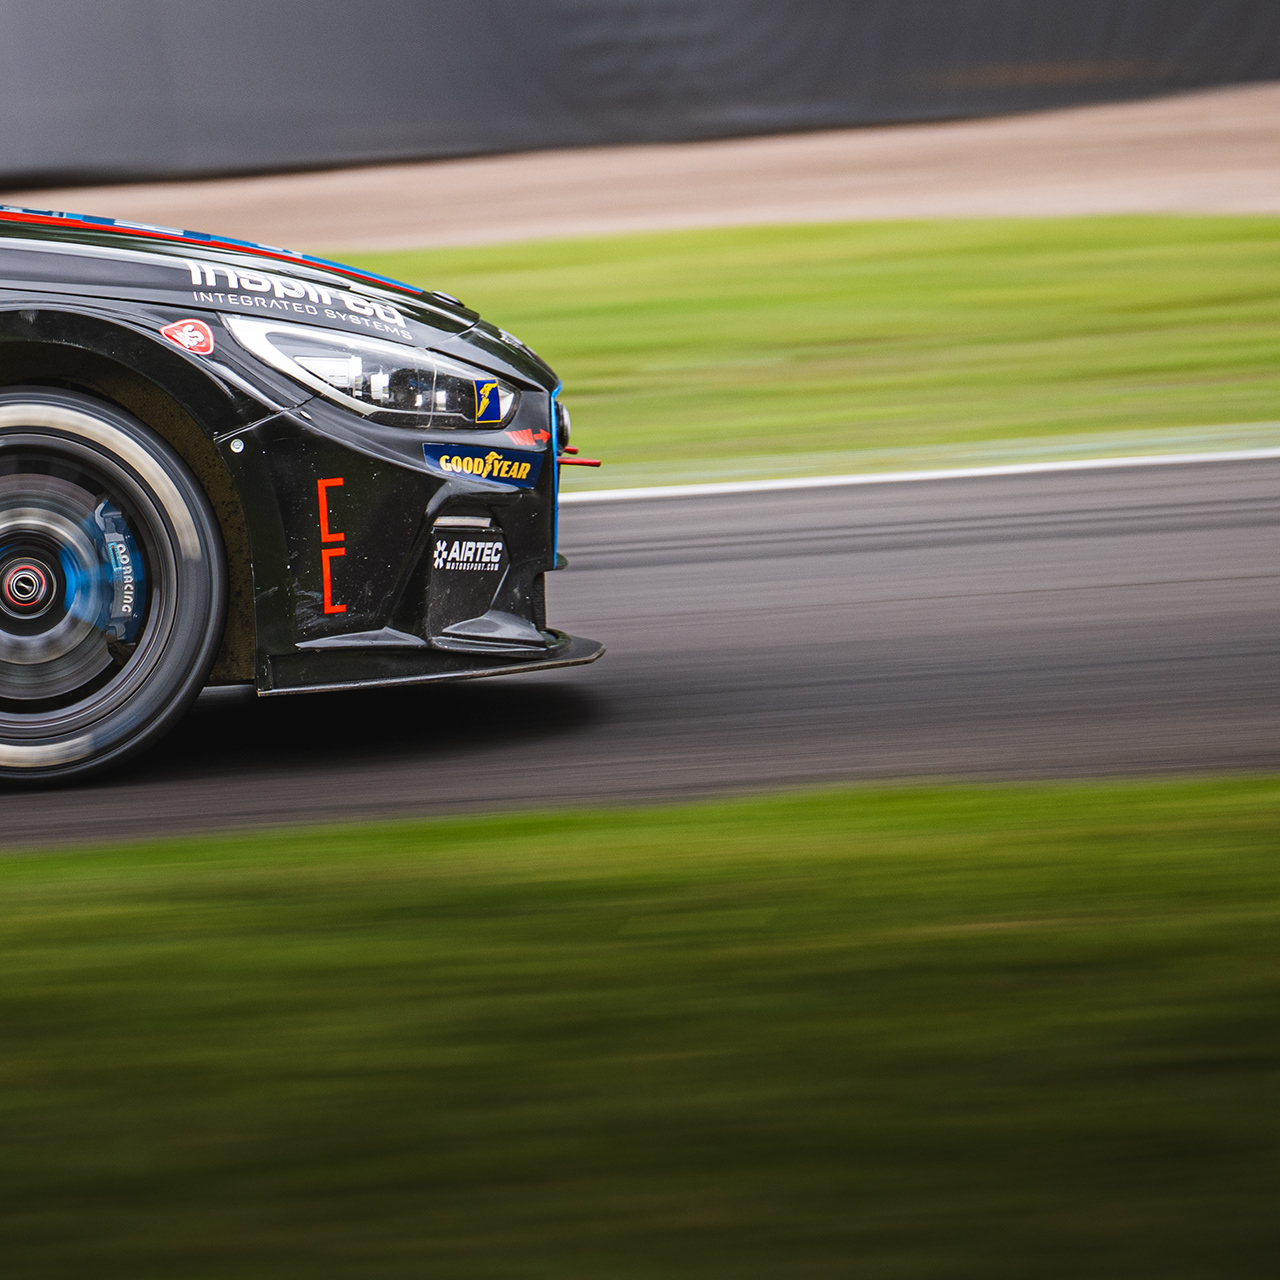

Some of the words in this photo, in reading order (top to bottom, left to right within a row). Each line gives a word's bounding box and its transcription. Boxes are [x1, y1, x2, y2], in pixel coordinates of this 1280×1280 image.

[192, 290, 318, 316] INTEGRATED
[325, 308, 413, 341] SYSTEMS
[445, 562, 500, 571] MOTORSPORT.COM
[447, 540, 503, 563] AIRTEC
[121, 567, 134, 613] RACING
